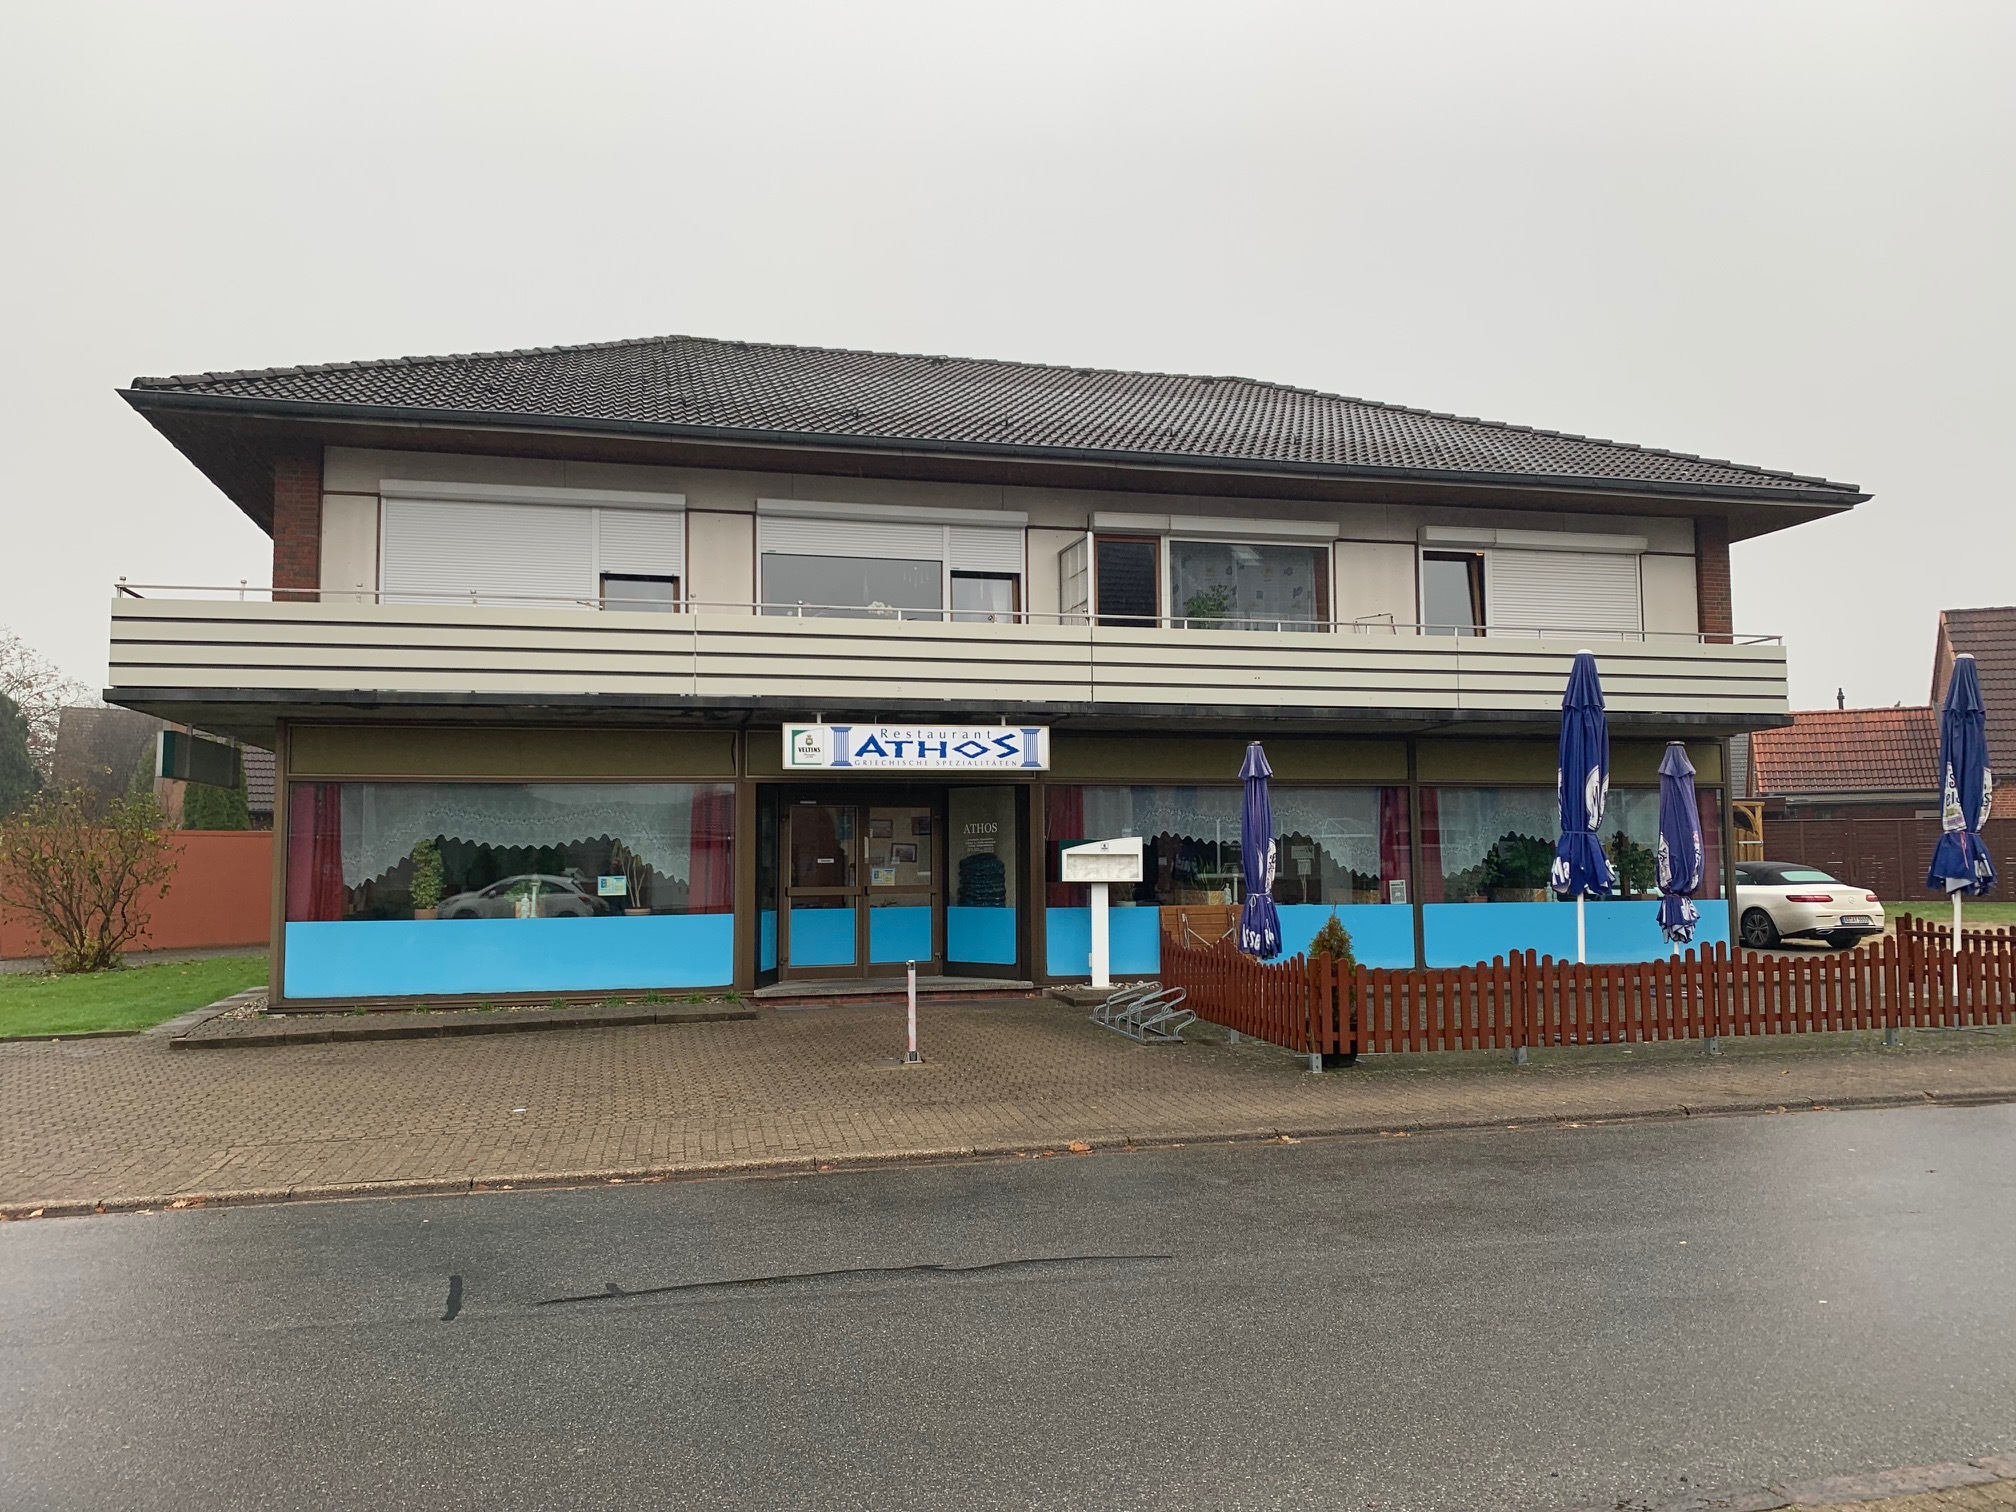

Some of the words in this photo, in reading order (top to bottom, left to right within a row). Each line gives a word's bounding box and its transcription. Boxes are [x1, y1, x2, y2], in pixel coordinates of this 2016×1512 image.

[881, 729, 992, 739] Restaurant
[854, 733, 1019, 758] ATHOS
[854, 759, 928, 767] GRIECHISCHE
[963, 822, 998, 834] ATHOS
